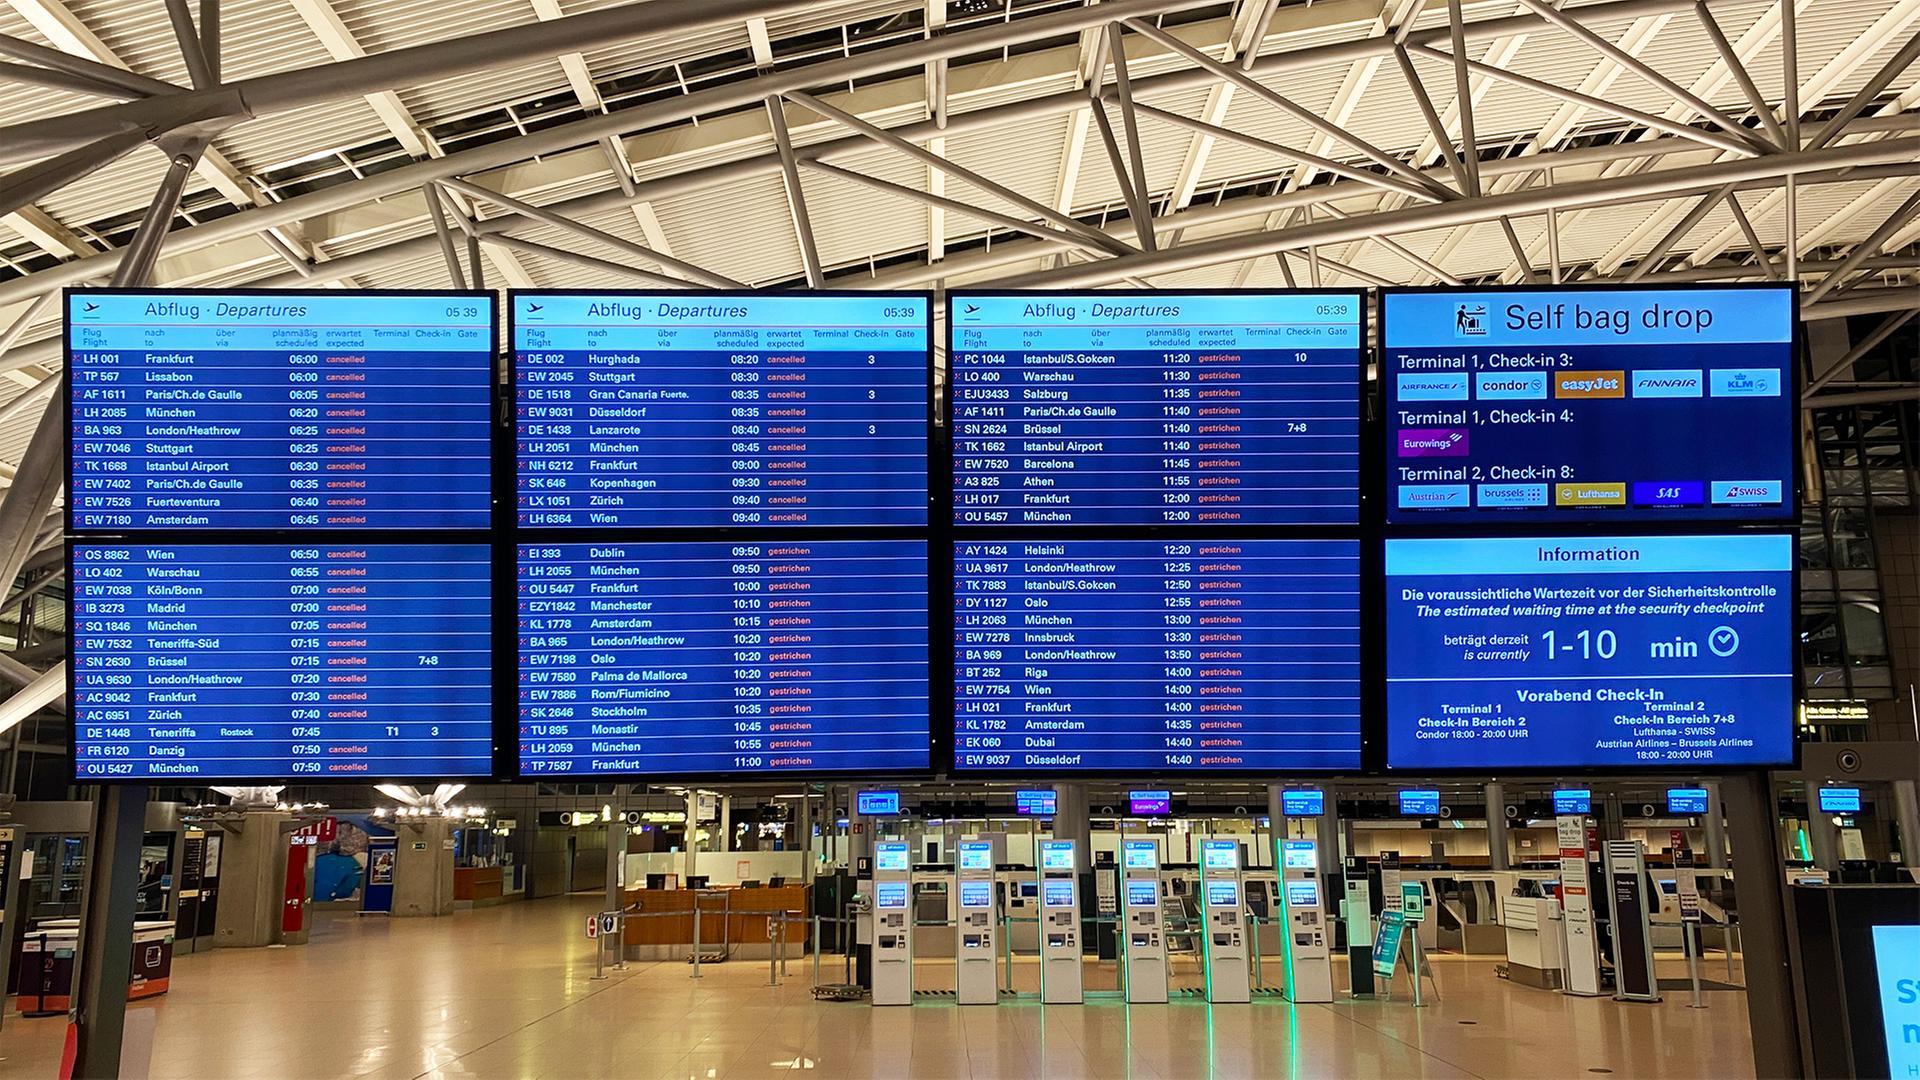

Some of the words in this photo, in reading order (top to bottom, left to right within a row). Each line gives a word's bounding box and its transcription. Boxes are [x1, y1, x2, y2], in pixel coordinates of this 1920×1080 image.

[145, 302, 199, 319] Abflug
[216, 303, 306, 319] Departures
[588, 303, 641, 320] Abflug
[658, 304, 747, 319] Departures
[884, 308, 914, 317] 05:39
[1023, 304, 1075, 320] Abflug
[1092, 304, 1179, 318] Departures
[1317, 306, 1347, 315] 05:39
[1507, 304, 1564, 330] Self
[1576, 304, 1629, 334] bag
[1643, 304, 1712, 333] drop
[527, 329, 545, 340] Flug
[714, 330, 758, 340] planmäßig
[814, 329, 848, 337] Terminal
[527, 339, 550, 348] Flight
[767, 340, 804, 348] expected
[84, 354, 98, 363] LH
[101, 354, 118, 363] 001
[146, 354, 193, 363] Frankfurt
[290, 355, 318, 364] 06:00
[528, 354, 542, 363] DE
[545, 354, 564, 363] 002
[588, 354, 640, 365] Hurghada
[731, 355, 758, 364] 08:20
[868, 355, 874, 364] 3
[965, 354, 978, 364] PC
[982, 355, 1005, 364] 1044
[1024, 354, 1114, 364] Istanbul/S.Gokcen
[1164, 354, 1190, 362] 11:20
[1199, 354, 1240, 362] gestrichen
[1295, 353, 1306, 362] 10
[1398, 354, 1465, 368] Terminal
[1472, 355, 1484, 369] 1,
[1490, 354, 1554, 367] Check-in
[1560, 354, 1572, 366] 3:
[1483, 380, 1528, 390] condor
[1562, 378, 1618, 392] easyJet
[1728, 379, 1752, 388] KLM
[965, 390, 1009, 398] EJU3433
[1024, 390, 1068, 400] Salzburg
[1164, 389, 1190, 398] 11:35
[1199, 390, 1240, 398] gestrichen
[1398, 410, 1466, 424] Terminal
[1473, 411, 1484, 425] 1,
[1490, 409, 1555, 423] Check-in
[1560, 409, 1573, 422] 4:
[1404, 438, 1451, 449] Eurowings
[85, 444, 102, 452] EW
[105, 444, 130, 452] 7046
[146, 444, 193, 456] Stuttgart
[290, 444, 318, 453] 06:25
[326, 445, 365, 453] cancelled
[1399, 466, 1466, 480] Terminal
[1472, 466, 1485, 481] 2,
[1491, 466, 1555, 479] Check-in
[1561, 466, 1574, 478] 8:
[1409, 492, 1446, 500] Austrian
[1485, 489, 1524, 499] brussels
[1656, 488, 1680, 498] SAS
[966, 546, 981, 554] AY
[984, 546, 1007, 554] 1424
[1025, 546, 1064, 554] Helsinki
[1164, 546, 1190, 554] 12:20
[1200, 546, 1241, 554] gestrichen
[1539, 547, 1639, 561] Information
[1402, 589, 1423, 600] Die
[1427, 588, 1531, 600] voraussichtliche
[1534, 587, 1595, 598] Wartezeit
[1623, 587, 1644, 598] der
[1648, 585, 1776, 597] Sicherheitskontrolle
[530, 602, 575, 611] EZY1842
[591, 601, 652, 610] Manchester
[734, 600, 760, 608] 10:10
[769, 600, 810, 608] gestrichen
[1417, 606, 1440, 616] The
[1444, 605, 1510, 616] estimated
[1513, 604, 1562, 618] waiting
[1566, 604, 1594, 614] time
[1598, 604, 1612, 614] at
[1615, 603, 1636, 614] the
[1639, 602, 1690, 616] security
[1694, 602, 1764, 615] checkpoint
[1444, 635, 1486, 647] beträgt
[1490, 634, 1528, 644] derzeit
[1543, 630, 1616, 659] 1-10
[1651, 637, 1697, 657] min
[1464, 650, 1473, 660] is
[1477, 647, 1530, 661] currently
[1517, 689, 1591, 702] Vorabend
[1597, 688, 1663, 701] Check-In
[1441, 704, 1491, 714] Terminal
[1496, 704, 1501, 713] 1
[1644, 702, 1694, 711] Terminal
[1698, 702, 1704, 710] 2
[1418, 718, 1468, 727] Check-In
[1472, 717, 1515, 726] Bereich
[1519, 717, 1526, 726] 2
[1614, 715, 1664, 724] Check-In
[1668, 714, 1710, 724] Bereich
[1714, 714, 1734, 723] 7+8
[88, 728, 102, 737] DE
[106, 728, 130, 737] 1448
[148, 728, 196, 738] Teneriffa
[292, 728, 320, 736] 07:45
[386, 727, 398, 736] T1
[432, 727, 438, 736] 3
[1482, 730, 1506, 739] 20:00
[1508, 730, 1528, 738] UHR
[1685, 727, 1715, 735] SWISS
[1596, 740, 1633, 748] Austrian
